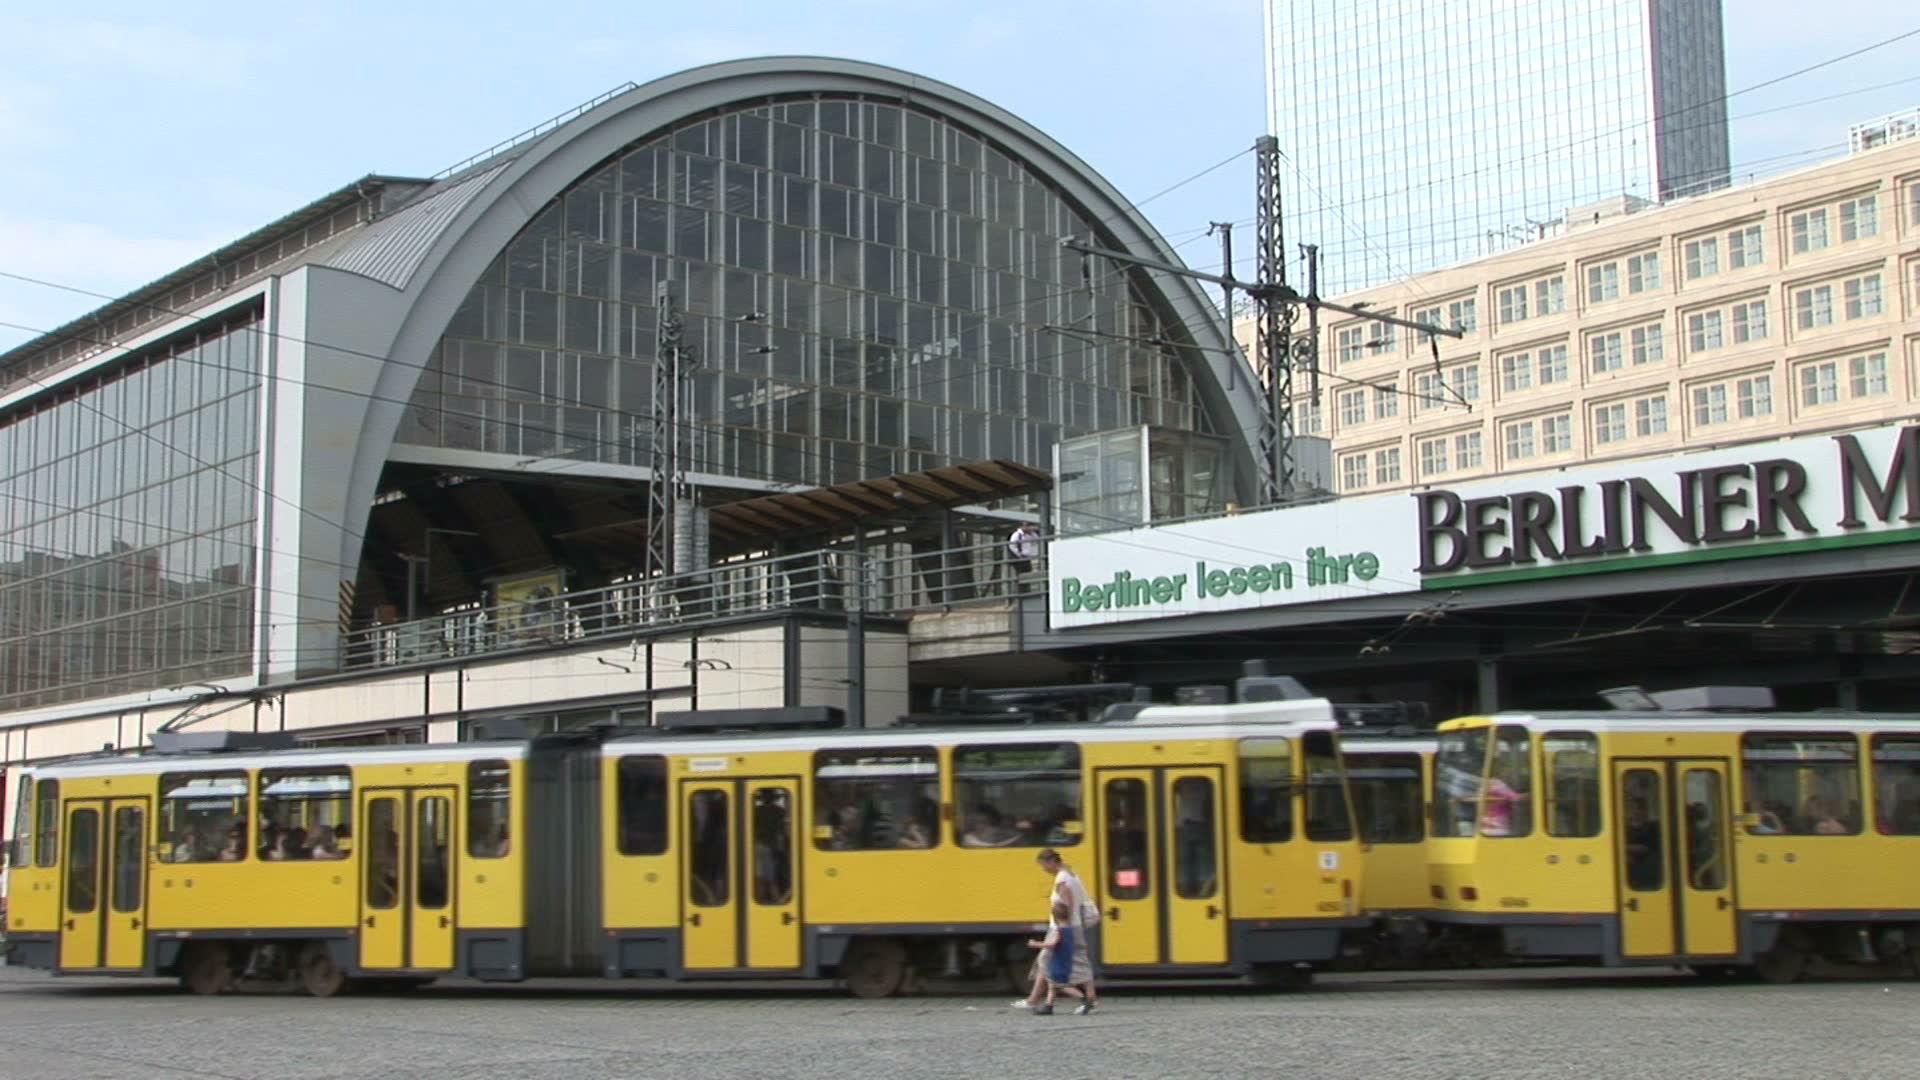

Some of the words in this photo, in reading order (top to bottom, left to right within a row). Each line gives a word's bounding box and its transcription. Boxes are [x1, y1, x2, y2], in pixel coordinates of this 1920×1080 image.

[1411, 457, 1818, 573] BERLINER
[1061, 569, 1187, 613] Berliner
[1196, 561, 1293, 599] lesen
[1305, 546, 1380, 588] ihre
